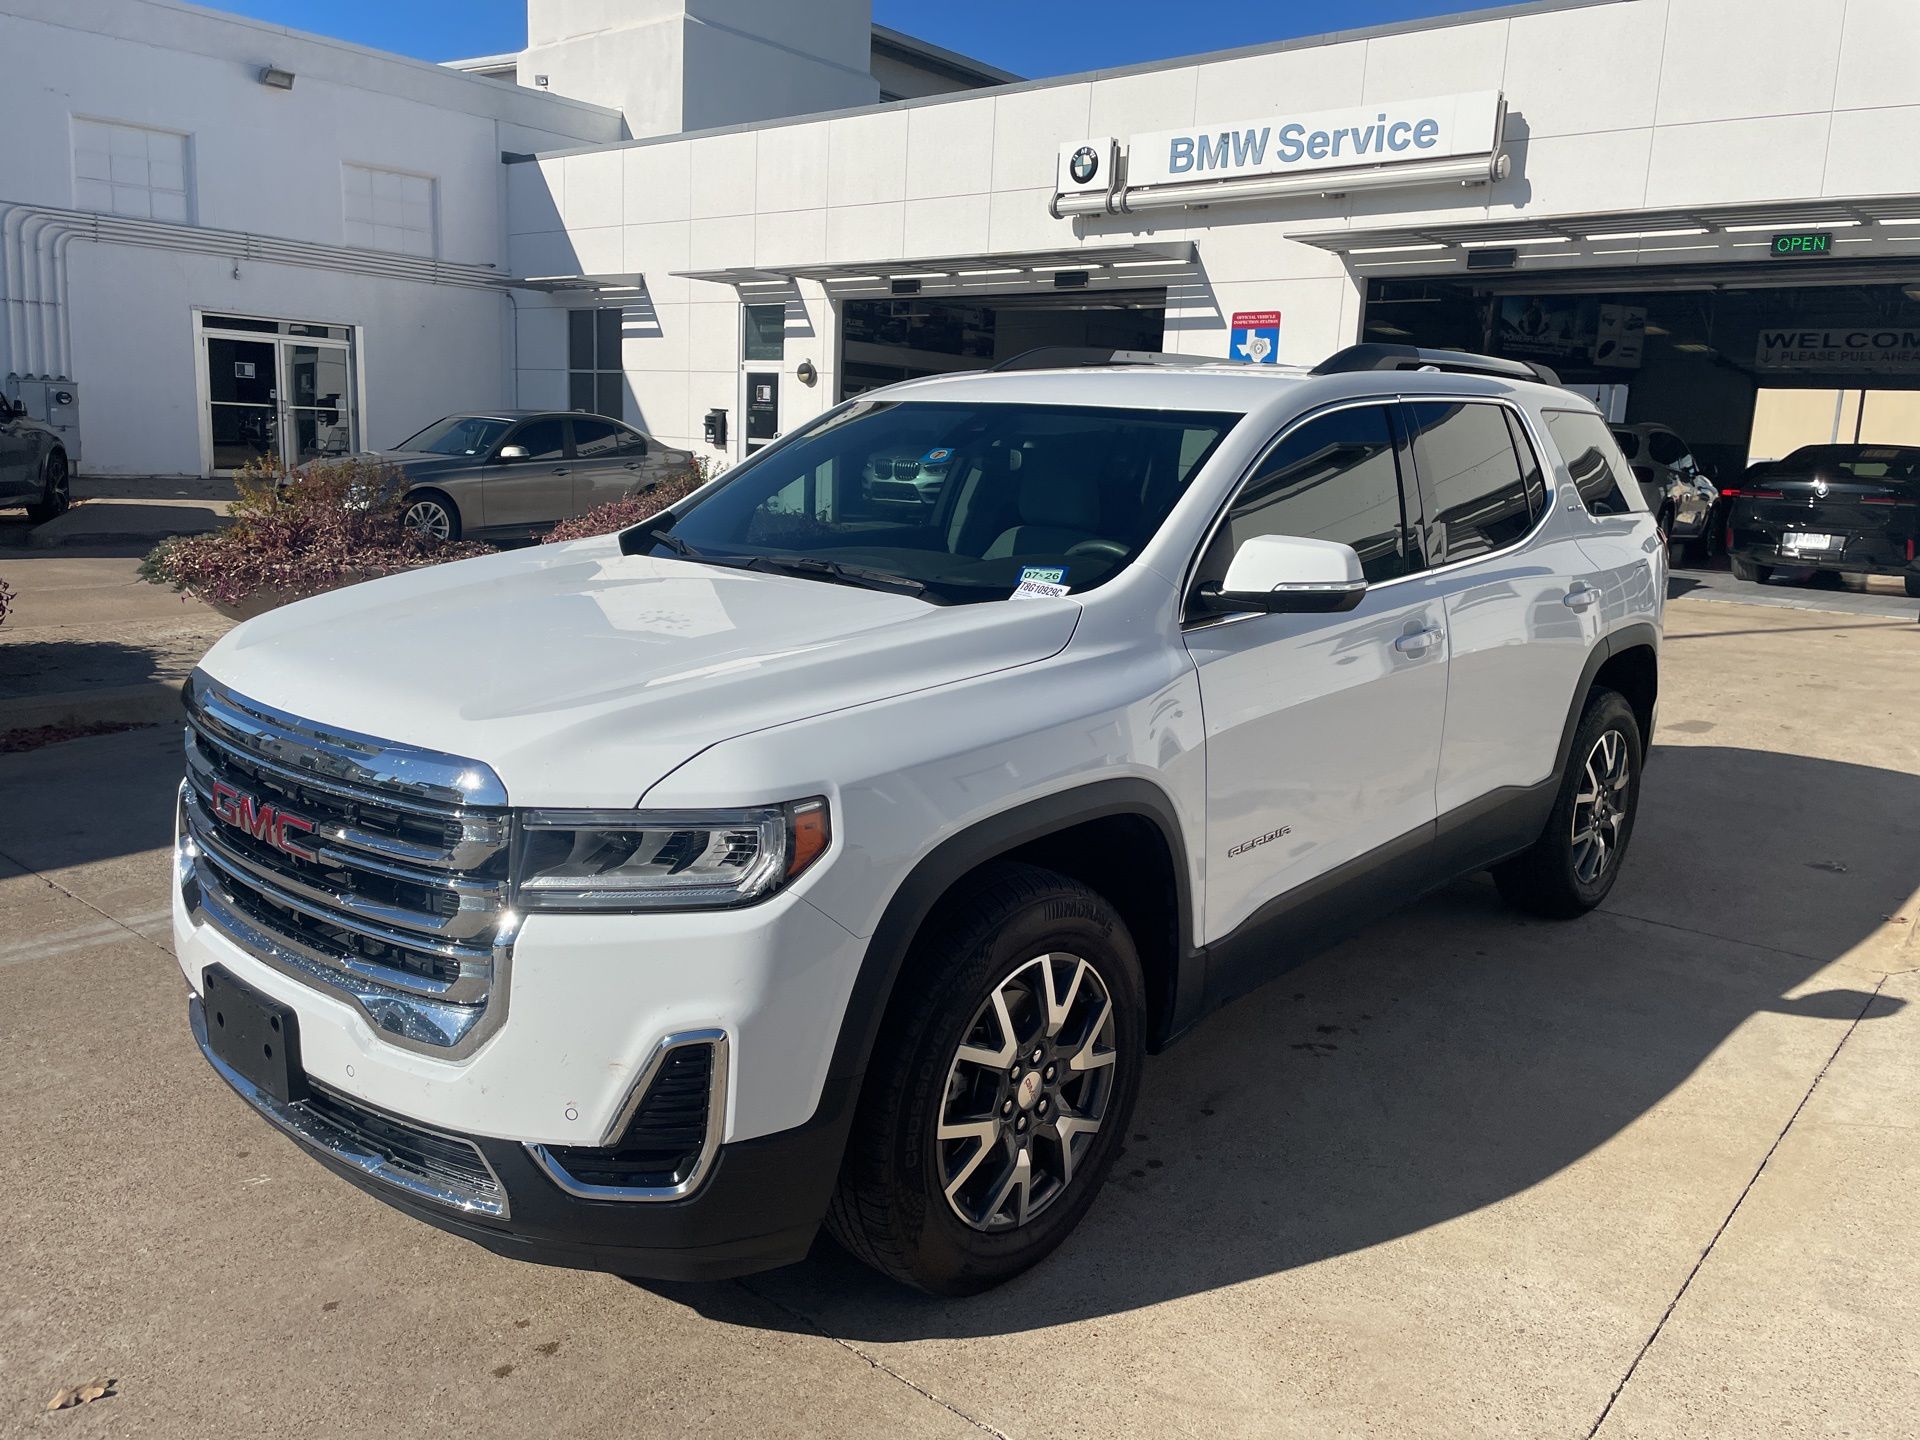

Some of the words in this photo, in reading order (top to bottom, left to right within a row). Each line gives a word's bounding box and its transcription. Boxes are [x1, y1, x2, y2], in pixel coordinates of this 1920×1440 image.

[1169, 127, 1271, 173] BMW
[1276, 112, 1439, 163] Service
[1777, 236, 1826, 251] OPEN
[1780, 351, 1836, 362] PLEASE
[1839, 351, 1876, 362] PULL
[211, 781, 320, 864] GMC
[1228, 824, 1291, 858] ACADIA
